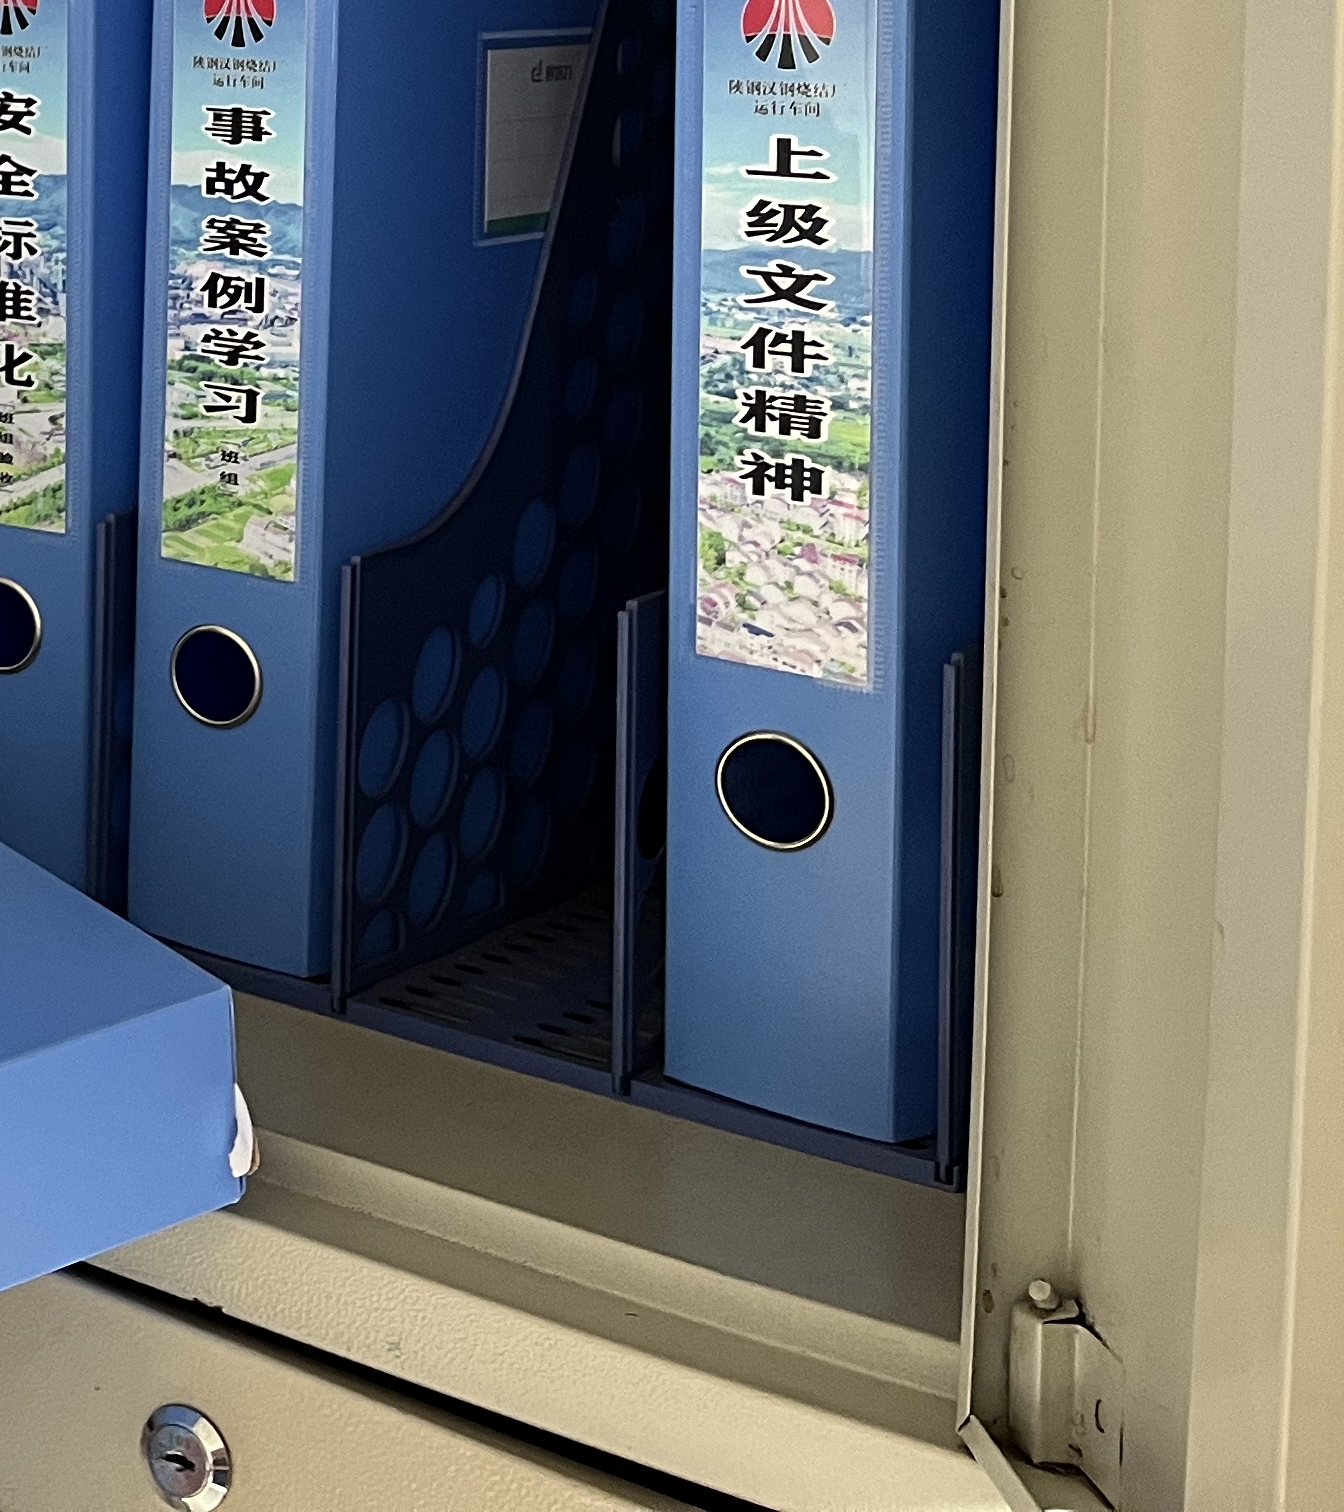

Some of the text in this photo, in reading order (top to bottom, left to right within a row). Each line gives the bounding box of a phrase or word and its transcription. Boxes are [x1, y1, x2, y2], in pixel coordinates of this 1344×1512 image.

[200, 107, 271, 424] 事故案例学习
[739, 138, 829, 502] 上级文件精神
